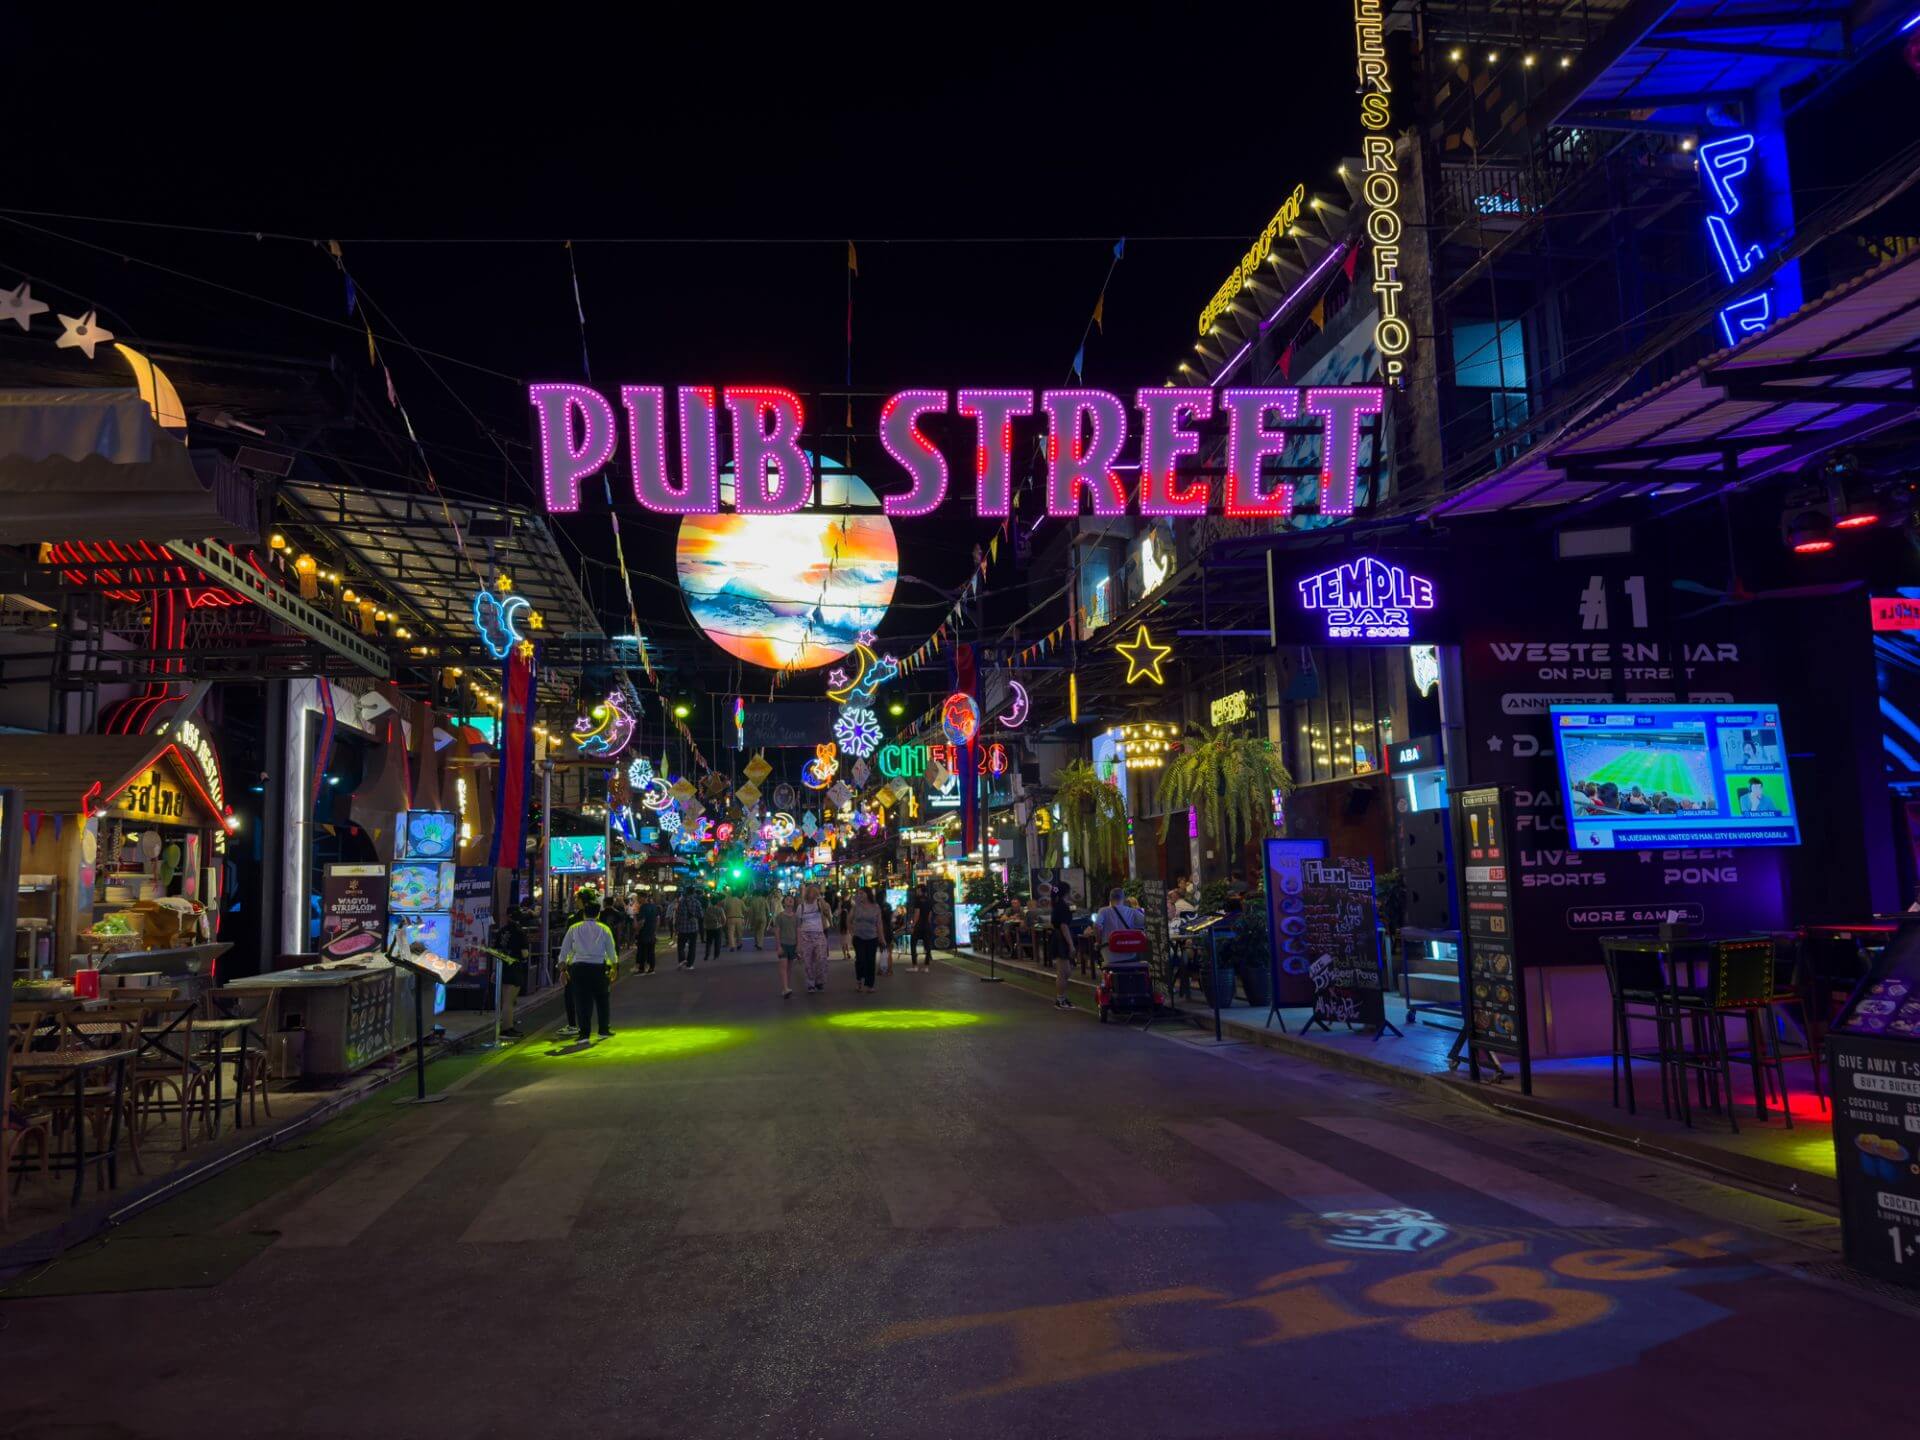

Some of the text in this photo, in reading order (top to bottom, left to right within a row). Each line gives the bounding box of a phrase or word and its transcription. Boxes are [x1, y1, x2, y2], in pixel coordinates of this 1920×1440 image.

[1199, 183, 1305, 336] CHEERS ROOFTOP
[529, 383, 1385, 517] PUB STREET
[1298, 556, 1434, 609] TEMPLE
[1578, 575, 1649, 630] #1
[1328, 608, 1409, 626] BAR
[1329, 626, 1363, 638] EST.
[1488, 642, 1741, 663] WESTERN AR
[1538, 667, 1697, 680] ON PUB STRET
[1399, 747, 1420, 764] ABA
[1520, 850, 1583, 867] LIVE
[1521, 867, 1739, 888] SPORTS PONG
[331, 904, 377, 912] STRIPLOIN
[337, 897, 369, 905] WAGYU
[1573, 910, 1627, 923] MORE
[1838, 1054, 1864, 1070] GIVE
[1867, 1056, 1897, 1074] AWAY
[1860, 1076, 1877, 1089] BUY
[1880, 1079, 1886, 1090] 2
[1848, 1096, 1889, 1112] COCKTAILS
[1849, 1109, 1875, 1123] MIXED
[1875, 1113, 1900, 1126] DRINK
